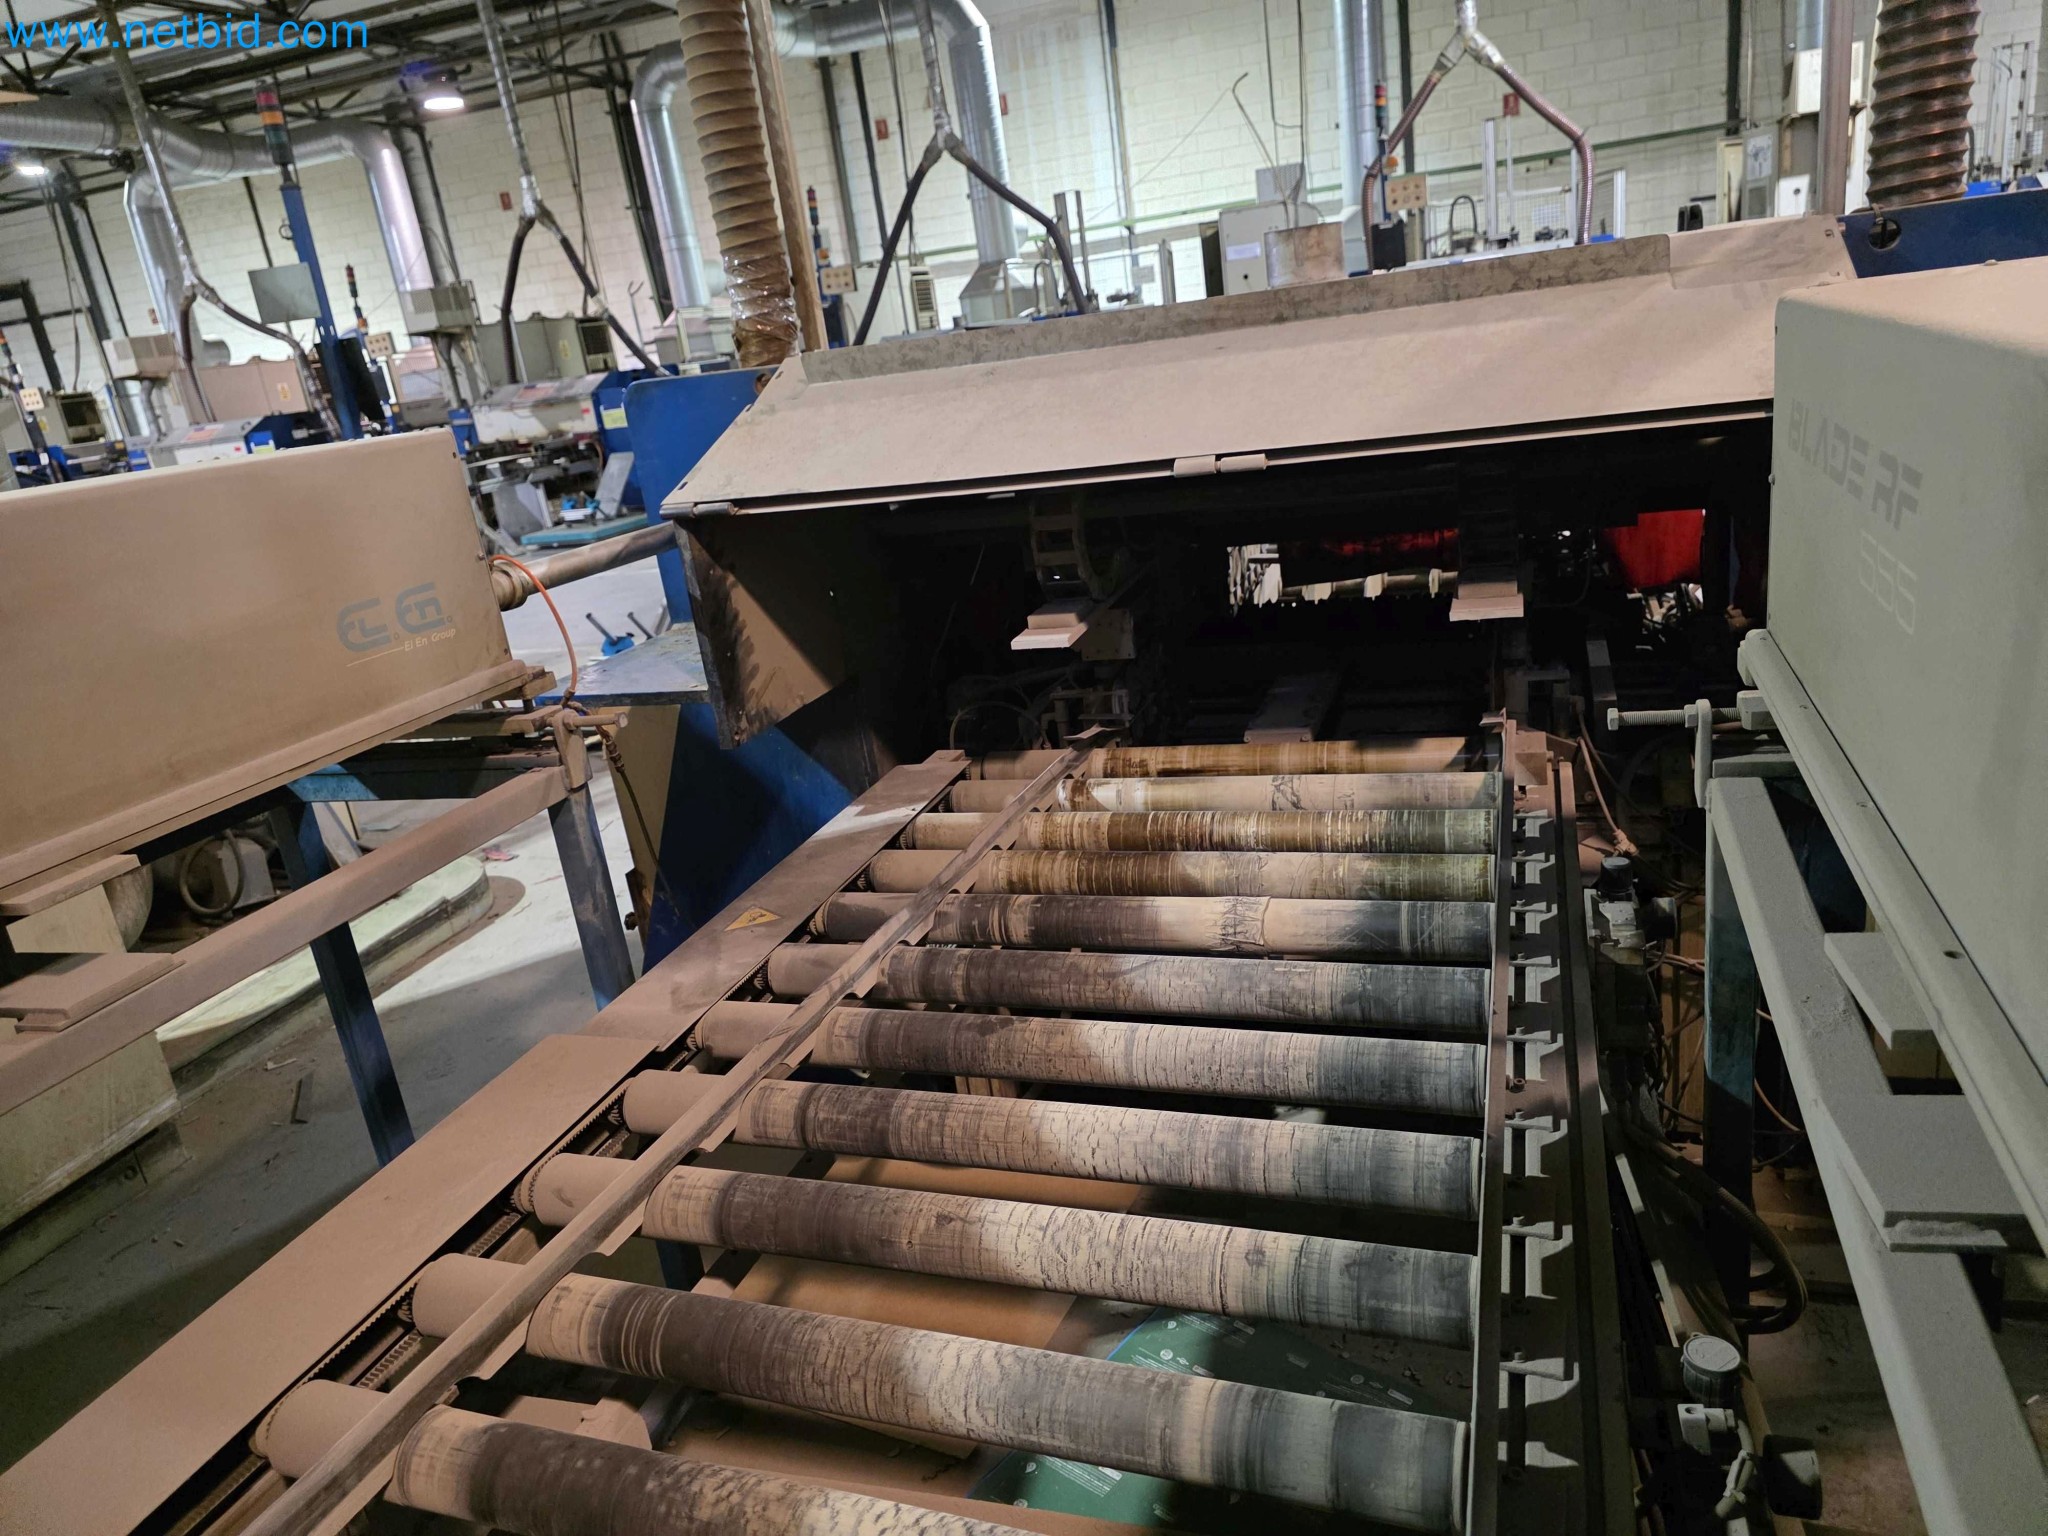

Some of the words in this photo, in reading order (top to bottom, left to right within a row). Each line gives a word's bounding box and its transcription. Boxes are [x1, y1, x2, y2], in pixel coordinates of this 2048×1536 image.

[1788, 398, 1870, 501] BLADE
[1871, 450, 1924, 531] RF
[404, 639, 414, 652] El
[415, 636, 428, 648] En
[431, 628, 456, 642] Group
